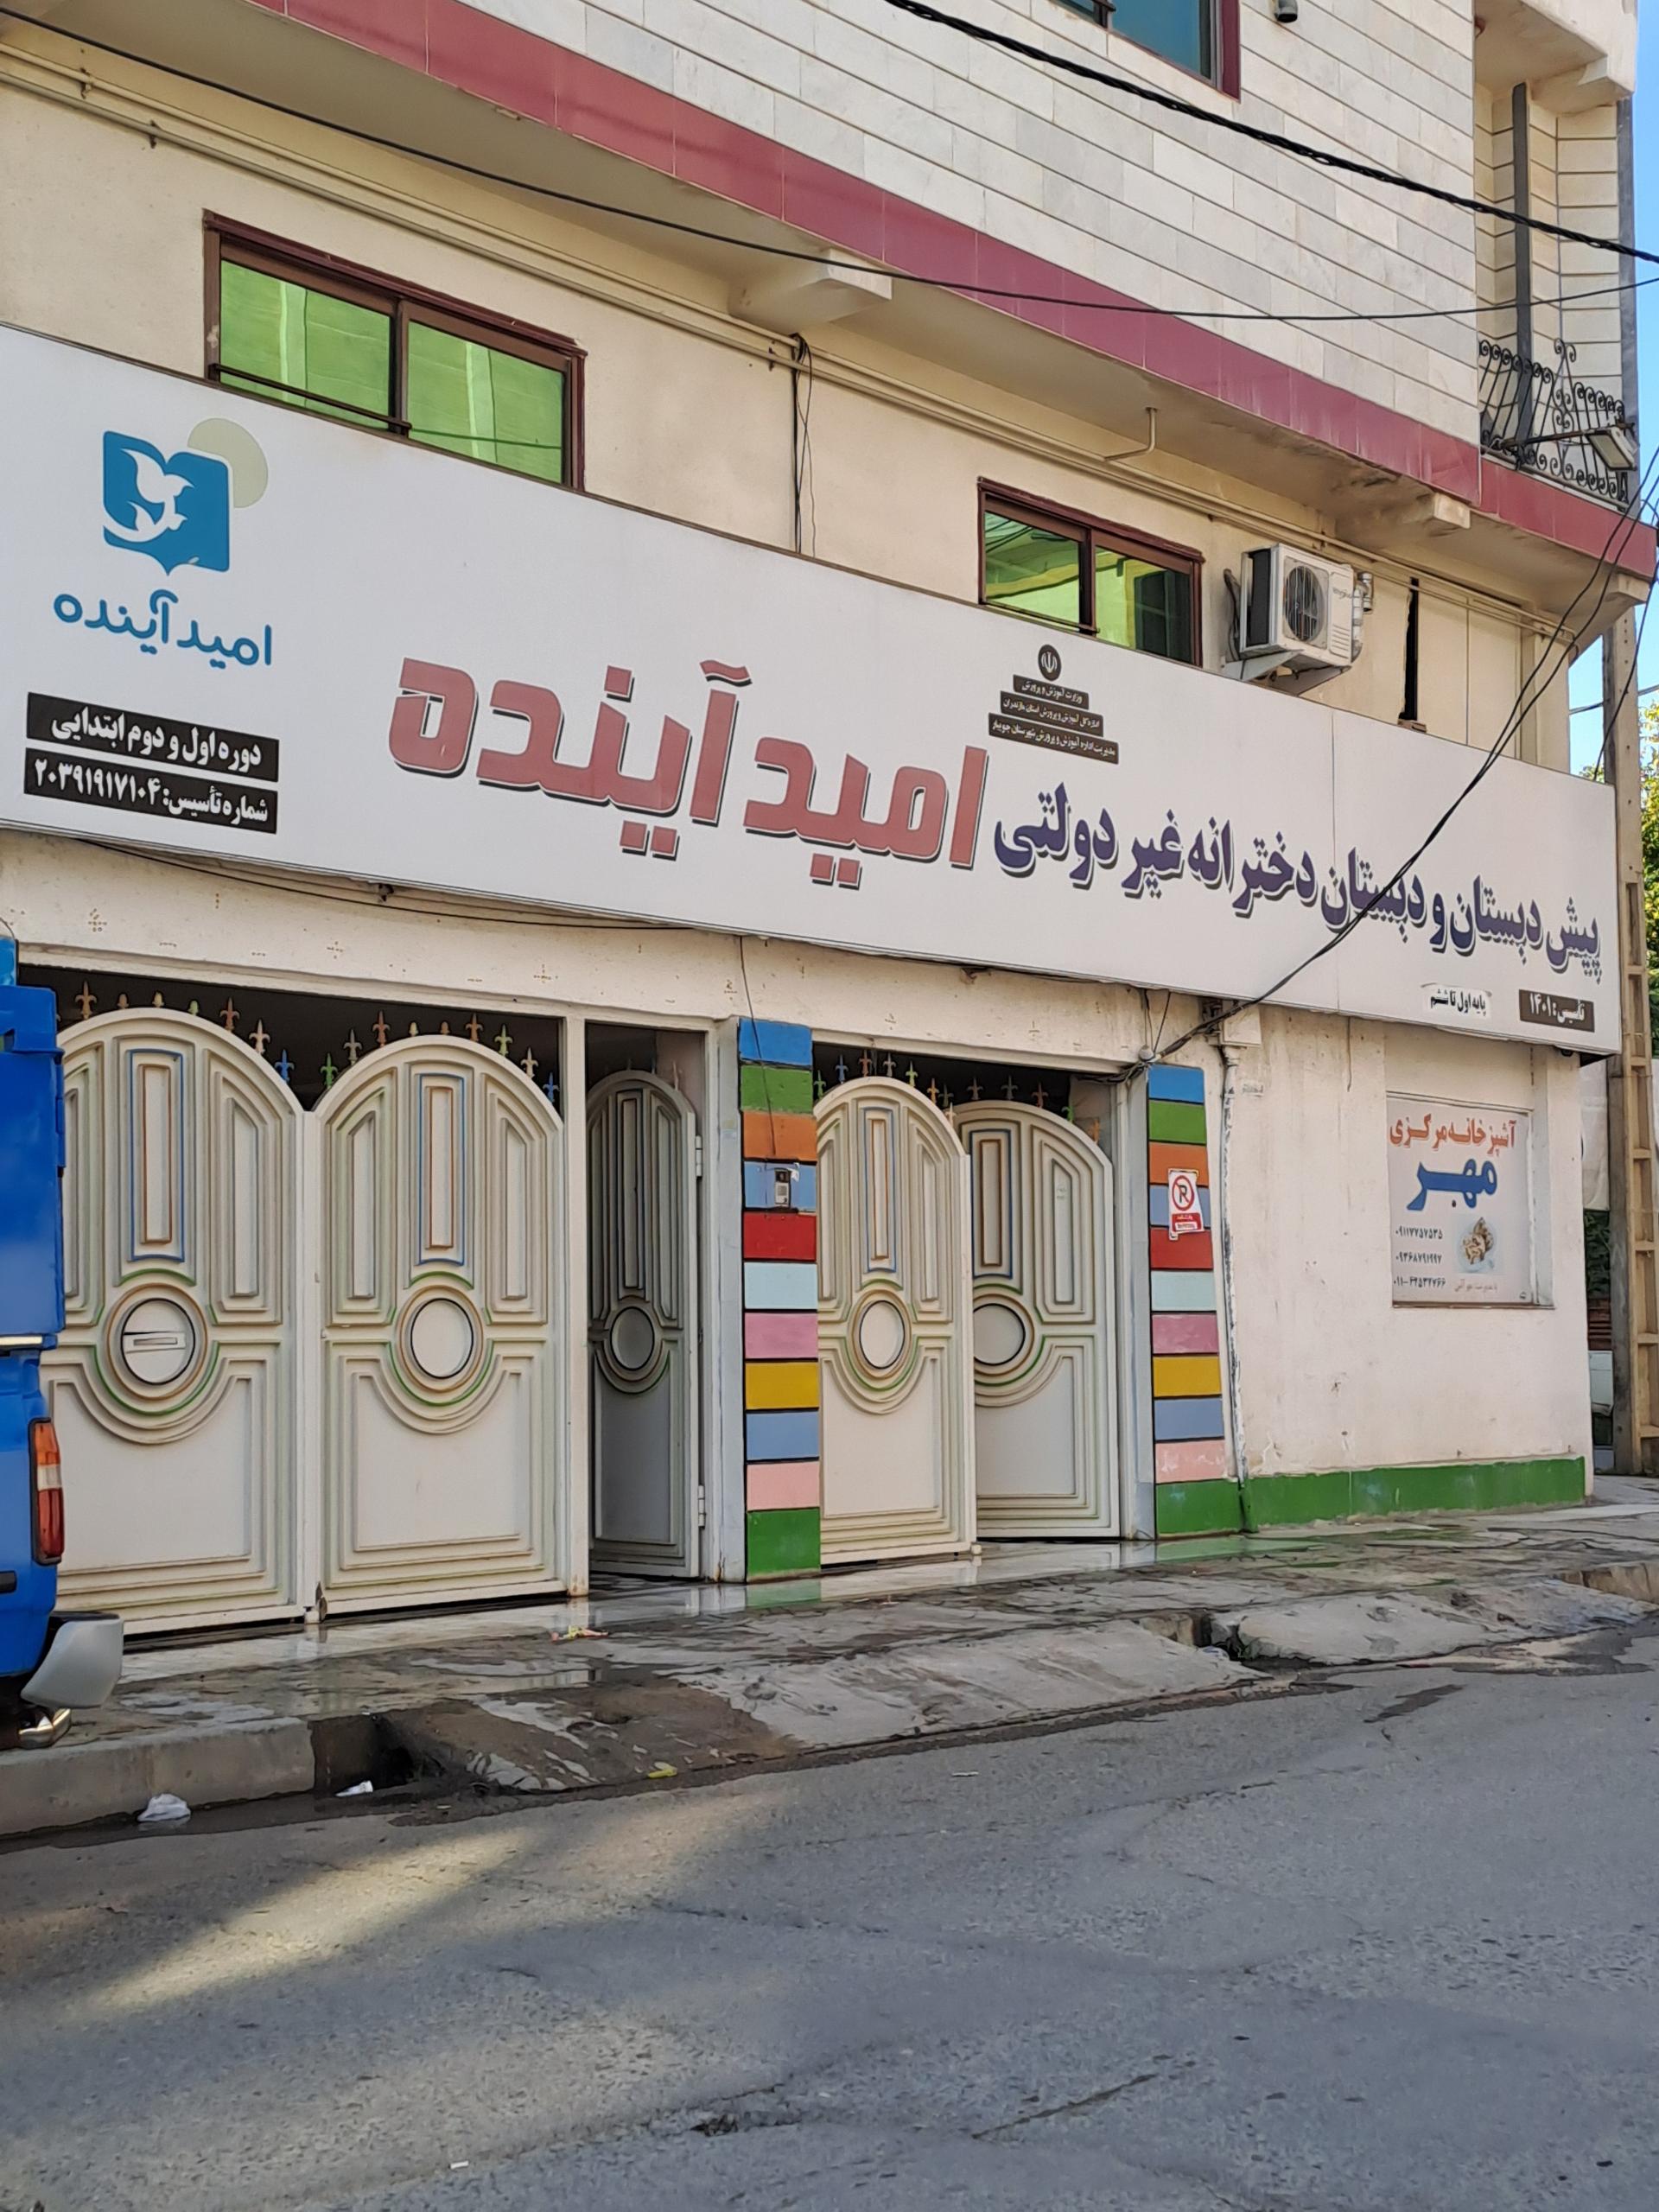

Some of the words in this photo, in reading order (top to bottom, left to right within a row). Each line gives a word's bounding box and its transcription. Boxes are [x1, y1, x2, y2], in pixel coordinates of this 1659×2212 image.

[53, 588, 179, 655] آینده
[176, 620, 272, 670] امید
[51, 706, 125, 749] ابتدایی
[128, 723, 165, 755] دوم
[167, 735, 180, 760] و
[181, 726, 215, 765] اول
[218, 741, 262, 773] دوره
[389, 657, 753, 861] آینده
[222, 795, 268, 824] شماره
[743, 737, 989, 890] امید
[994, 782, 1118, 890] دولتی
[1122, 809, 1184, 899] غیر
[1187, 817, 1319, 918] دخترانه
[1320, 847, 1427, 943] دبستان
[1430, 893, 1449, 952] و
[1450, 874, 1544, 965] دبستان
[1546, 897, 1602, 984] پیش
[1457, 991, 1471, 1014] اول
[1389, 1113, 1447, 1152] مرکزی
[1406, 1159, 1497, 1211] مهر
